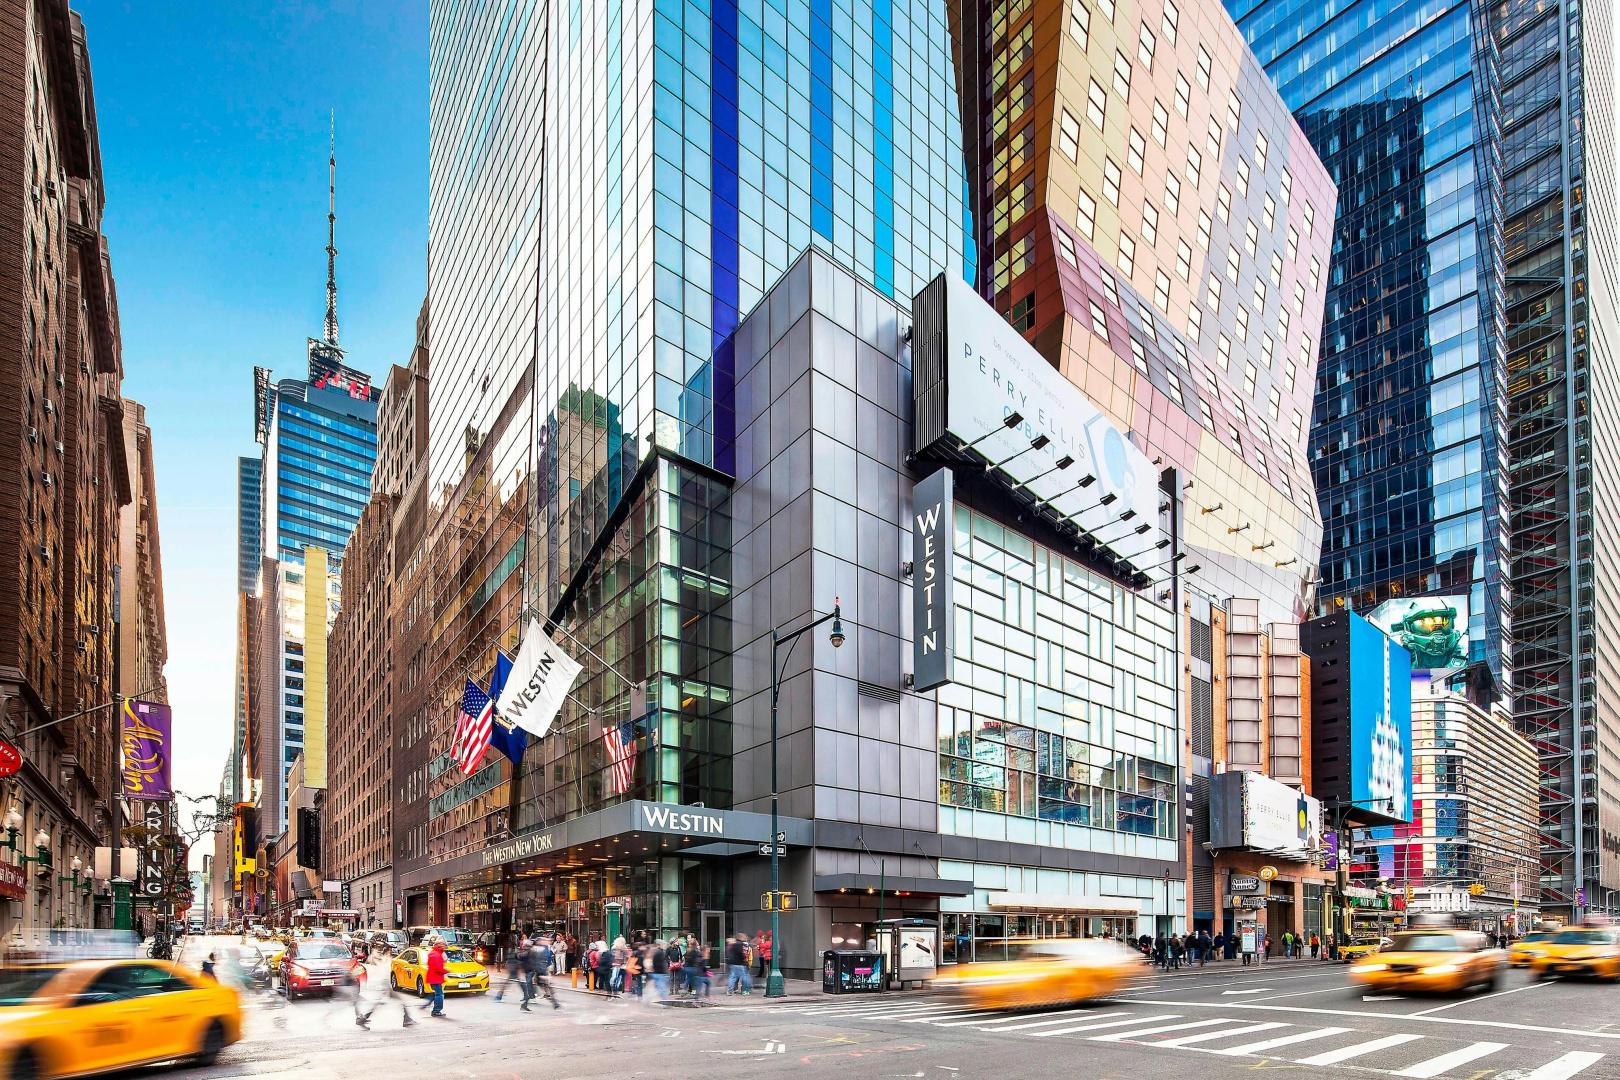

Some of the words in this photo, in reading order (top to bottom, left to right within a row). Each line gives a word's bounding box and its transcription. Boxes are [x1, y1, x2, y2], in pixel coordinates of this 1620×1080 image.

[964, 342, 1027, 408] PERRY
[1038, 407, 1085, 459] ELLIS
[916, 502, 941, 656] WESTIN
[507, 649, 556, 718] WESTIN
[124, 697, 164, 792] Aladdin
[146, 802, 162, 894] ARKING
[482, 850, 493, 866] THE
[493, 845, 516, 862] WESTIN
[515, 840, 532, 857] NEW
[532, 834, 553, 853] YORK
[642, 805, 723, 834] WESTIN
[1431, 894, 1470, 911] URBO
